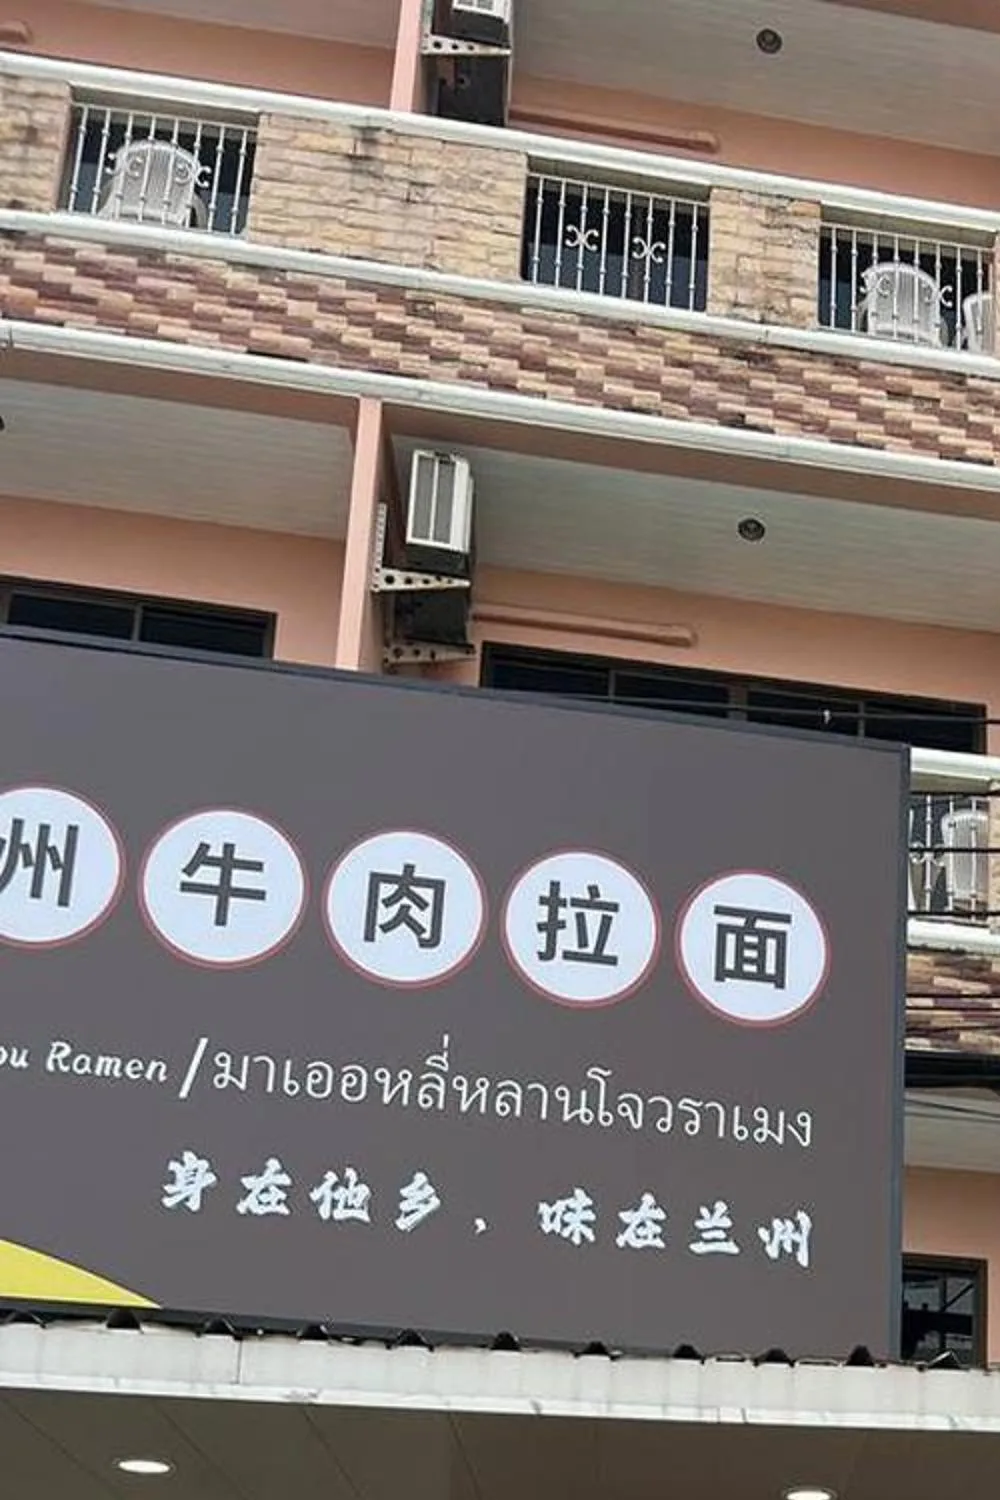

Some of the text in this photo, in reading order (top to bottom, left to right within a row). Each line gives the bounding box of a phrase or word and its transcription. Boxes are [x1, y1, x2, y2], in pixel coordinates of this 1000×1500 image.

[0, 818, 794, 990] 州牛肉拉面
[46, 1040, 168, 1083] Ramen
